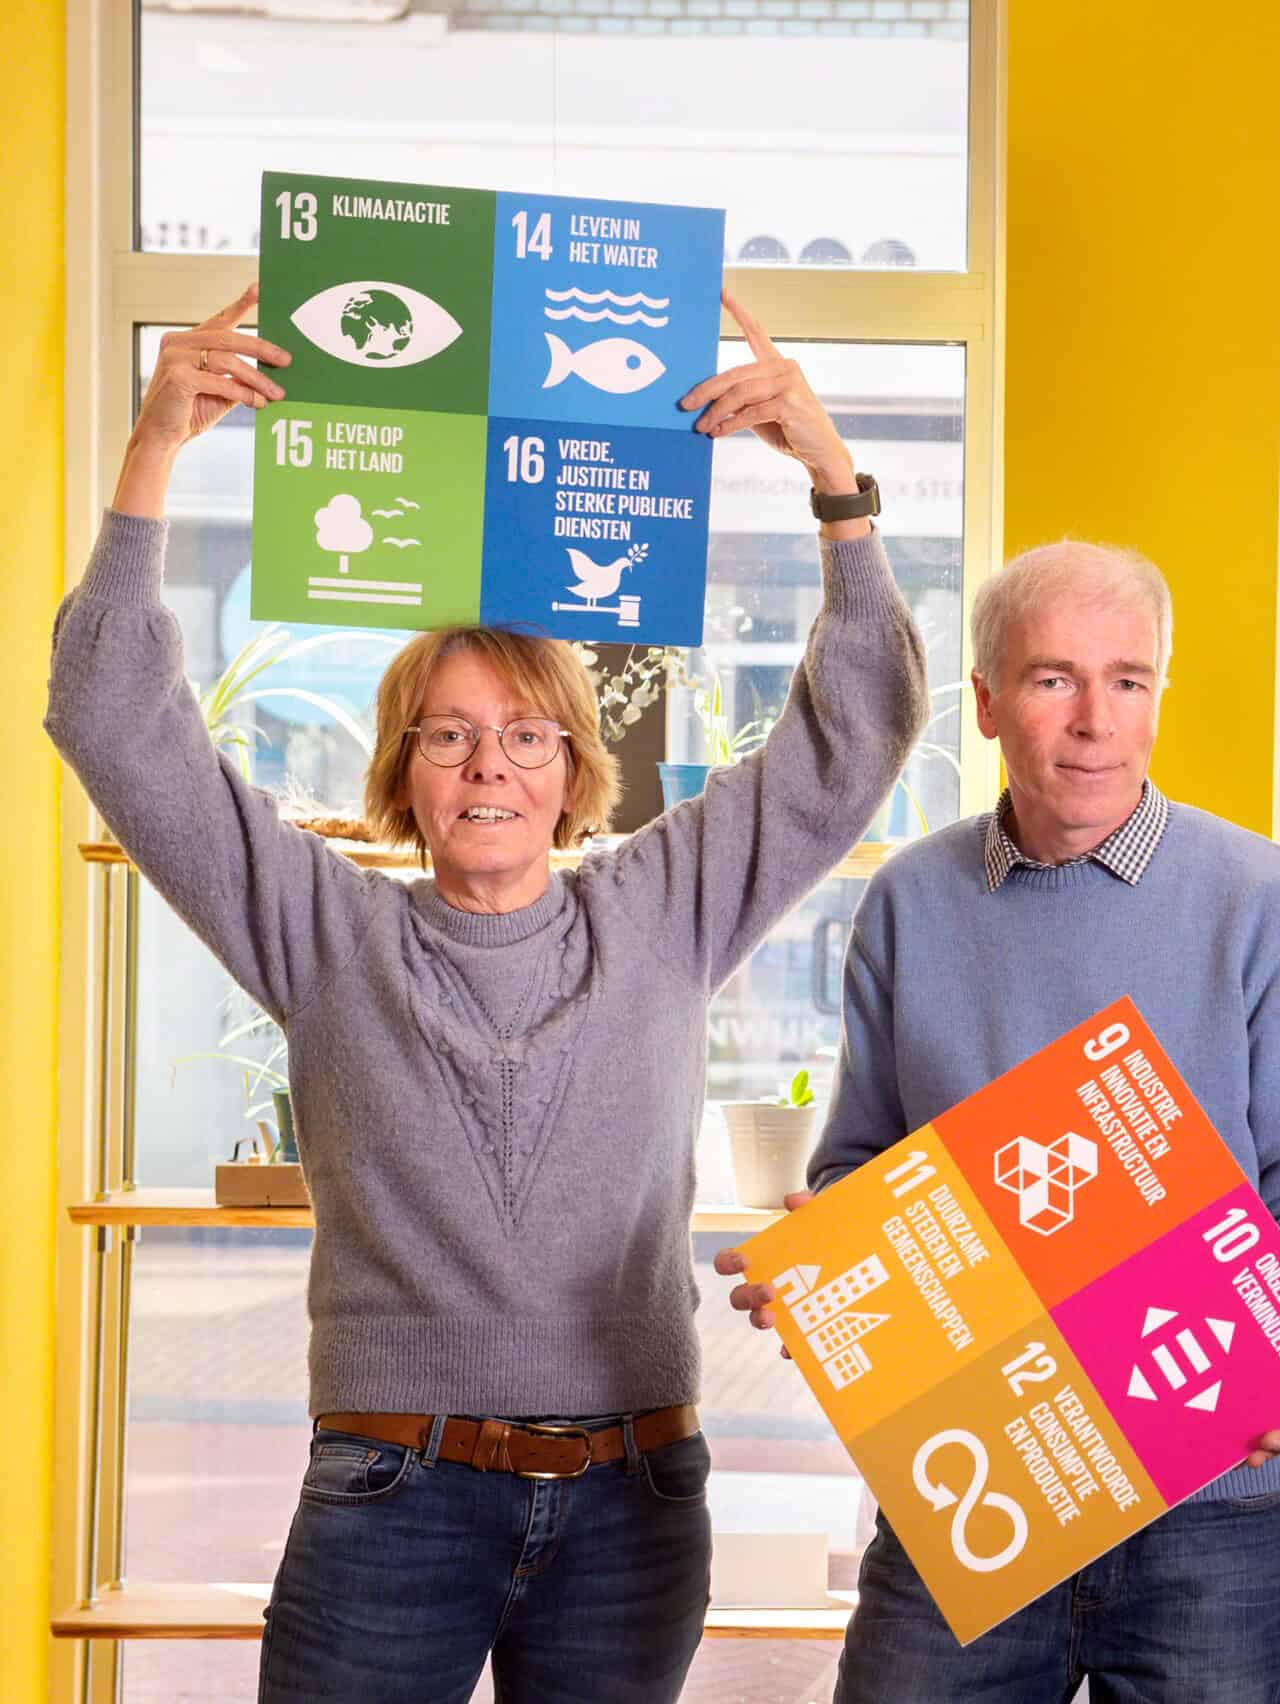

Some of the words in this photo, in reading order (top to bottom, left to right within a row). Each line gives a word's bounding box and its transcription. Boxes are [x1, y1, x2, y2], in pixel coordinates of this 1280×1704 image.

[275, 191, 318, 242] 13
[332, 194, 451, 225] KLIMAATACTIE
[570, 214, 621, 239] LEVEN
[624, 219, 641, 241] IN
[511, 210, 553, 261] 14
[569, 241, 600, 264] HET
[603, 243, 658, 269] WATER
[272, 418, 313, 468] 15
[326, 422, 377, 446] LEVEN
[380, 426, 403, 447] OP
[503, 435, 545, 484] 16
[558, 439, 615, 464] VREDE,
[326, 448, 357, 470] HET
[360, 451, 403, 473] LAND
[556, 465, 626, 489] JUSTITIE
[629, 470, 650, 491] EN
[554, 516, 632, 541] DIENSTEN
[555, 491, 616, 515] STERKE
[618, 495, 694, 520] PUBLIEKE
[1084, 1023, 1131, 1062] 9
[1100, 1064, 1159, 1141] INNOVATIE
[1144, 1133, 1172, 1161] EN
[1122, 1049, 1183, 1131] INDUSTRIE,
[1075, 1079, 1167, 1207] INFRASTRUCTUUR
[883, 1151, 937, 1199] 11
[904, 1200, 952, 1261] STEDEN
[937, 1253, 965, 1280] EN
[928, 1183, 990, 1268] DUURZAME
[1202, 1208, 1260, 1263] 10
[881, 1215, 975, 1352] GEMEENSCHAPPEN
[1001, 1342, 1057, 1397] 12
[1003, 1416, 1032, 1446] EN
[1029, 1402, 1100, 1502] CONSUMPTIE
[1053, 1384, 1141, 1512] VERANTWOORDE
[1016, 1437, 1081, 1527] PRODUCTIE
